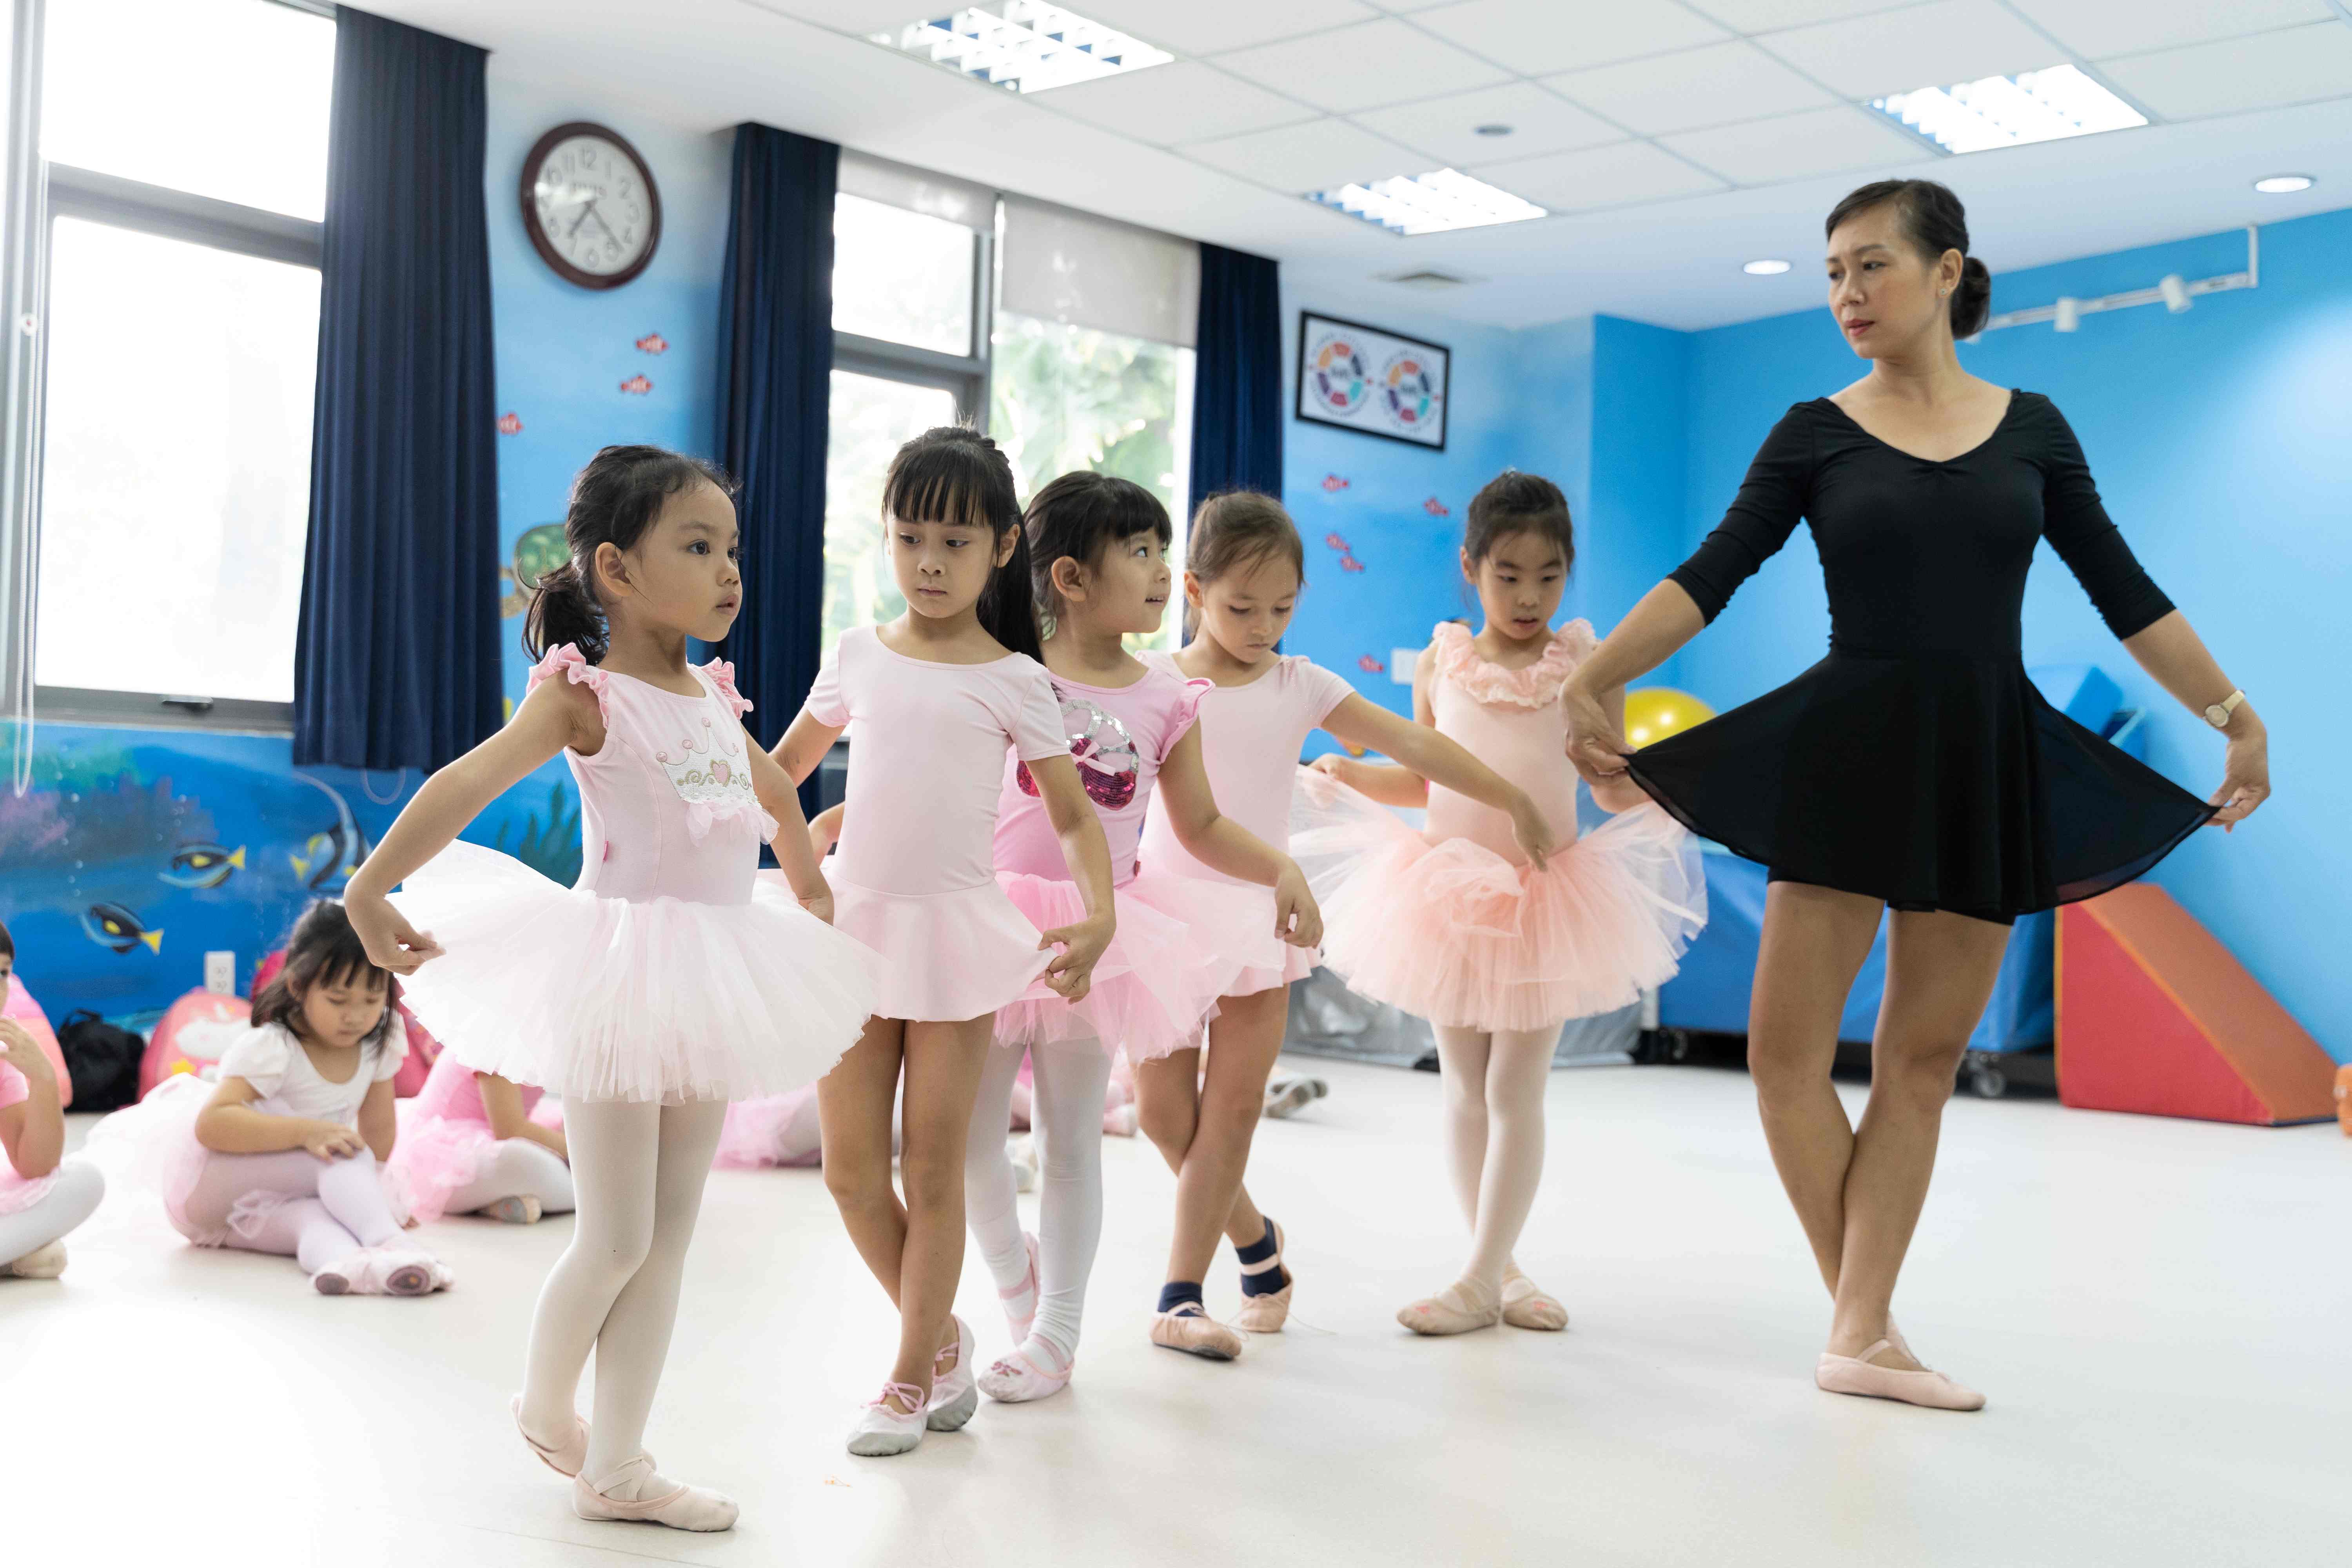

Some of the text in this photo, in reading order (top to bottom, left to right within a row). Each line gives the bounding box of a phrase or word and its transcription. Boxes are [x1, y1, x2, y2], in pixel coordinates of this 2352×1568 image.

[579, 145, 597, 170] 12
[545, 165, 562, 185] 10
[619, 176, 632, 199] 2
[626, 203, 640, 223] 3
[548, 217, 560, 237] 8
[624, 226, 633, 244] 4
[584, 247, 599, 267] 6
